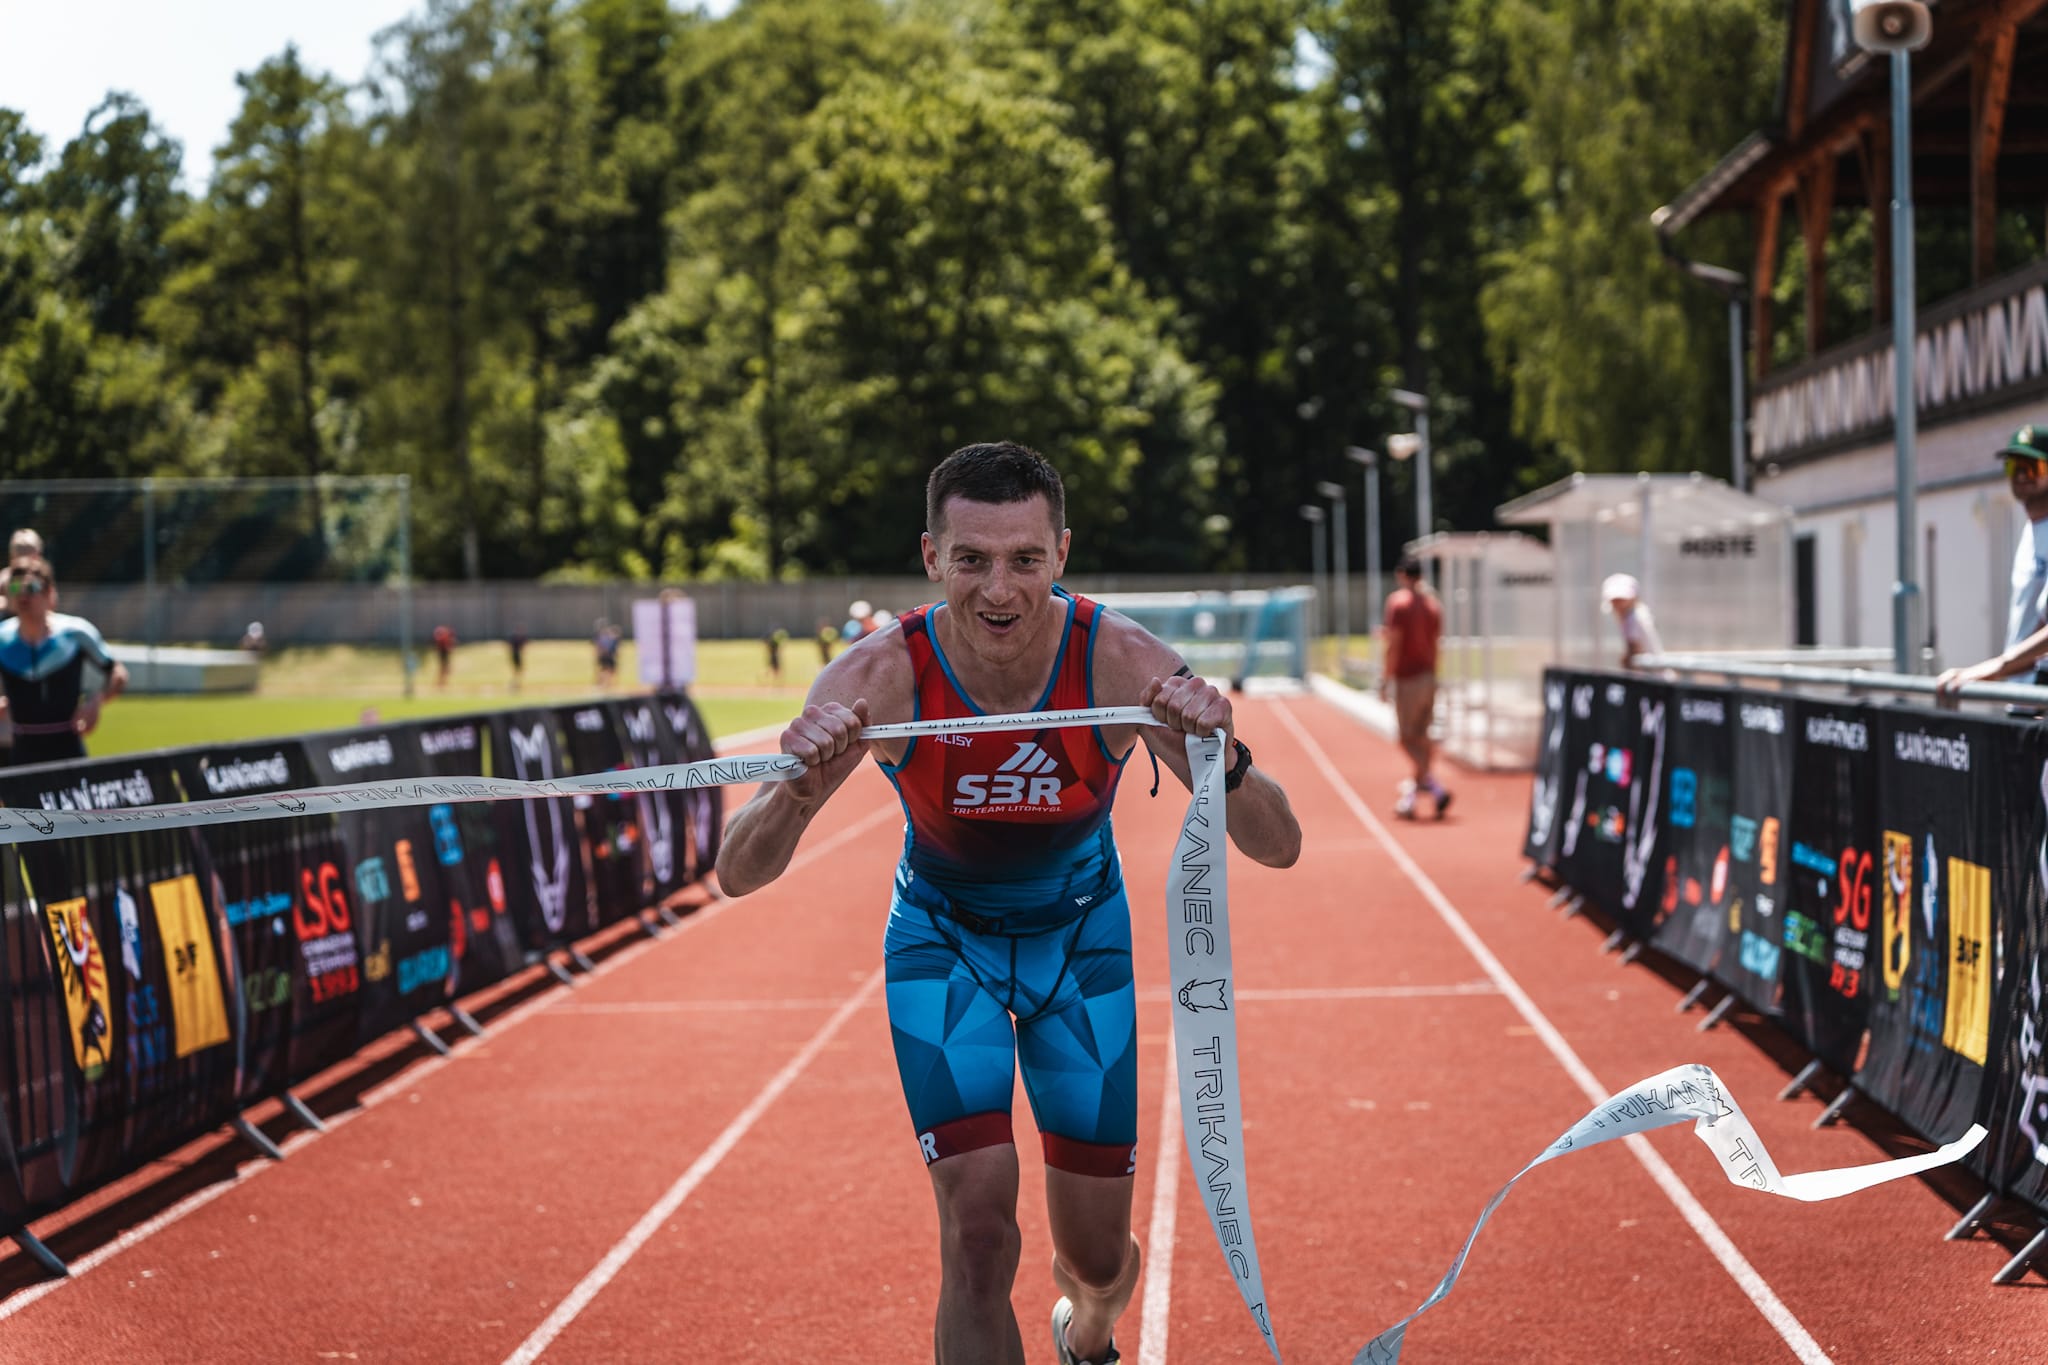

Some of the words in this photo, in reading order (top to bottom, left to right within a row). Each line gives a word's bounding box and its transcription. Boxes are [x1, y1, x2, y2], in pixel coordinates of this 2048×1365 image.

[325, 780, 514, 804] TRIKANEC
[953, 805, 1005, 815] TRI-TEAM
[1193, 1036, 1249, 1281] TRIKANEC
